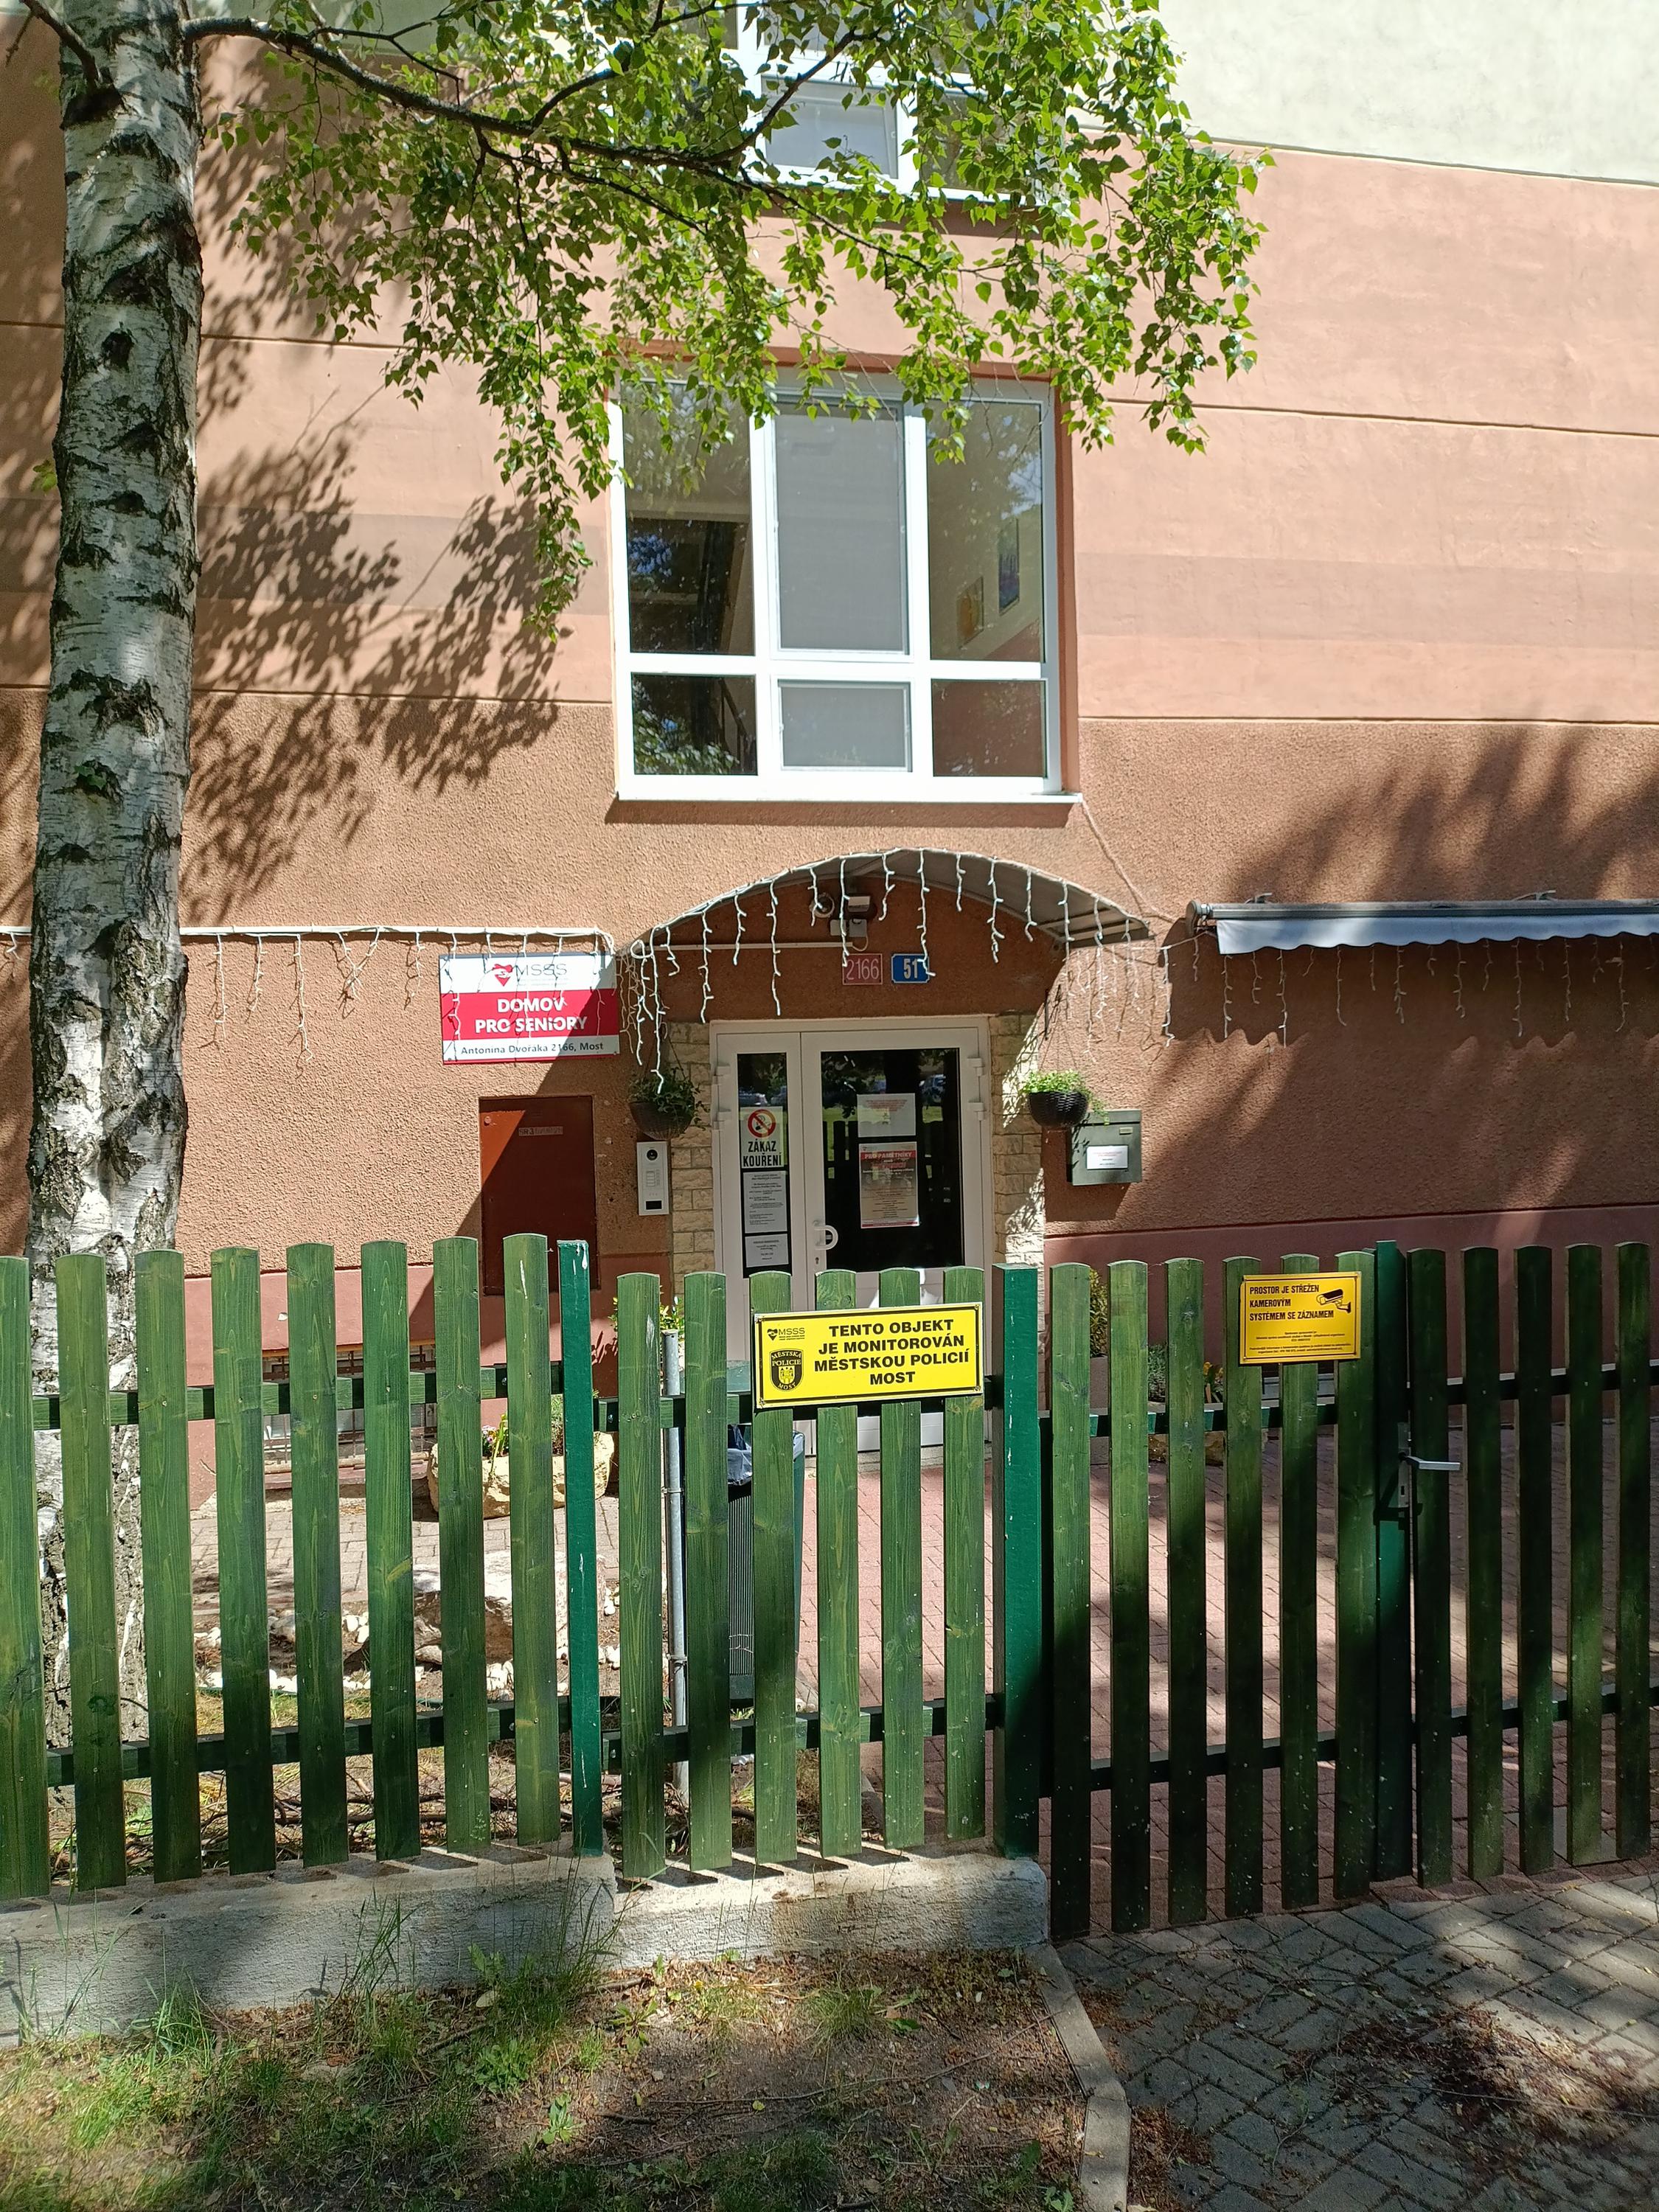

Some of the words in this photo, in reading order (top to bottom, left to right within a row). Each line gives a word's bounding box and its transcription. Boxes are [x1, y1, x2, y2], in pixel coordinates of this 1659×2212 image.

[515, 964, 568, 976] MSSS
[846, 958, 880, 981] 2166
[903, 958, 918, 979] 51
[498, 997, 564, 1013] DOMOV
[475, 1018, 511, 1034] PRO
[580, 1041, 604, 1052] Most
[748, 1138, 777, 1153] ZÁKAZ
[742, 1152, 782, 1167] KOUŘENÍ
[1249, 1286, 1280, 1295] PROSTOR
[1281, 1285, 1290, 1294] JE
[1291, 1283, 1320, 1293] STŘEŽEN
[1249, 1298, 1292, 1308] KAMEROVÝM
[1249, 1311, 1286, 1321] SYSTÉMEM
[1287, 1311, 1295, 1320] SE
[1297, 1310, 1335, 1320] ZÁZNAMEM
[779, 1327, 805, 1335] MSSS
[829, 1323, 885, 1338] TENTO
[889, 1319, 954, 1335] OBJEKT
[818, 1342, 839, 1354] JE
[844, 1333, 964, 1354] MONITOROVÁN
[771, 1359, 801, 1367] POLICIE
[814, 1355, 905, 1372] MĚSTSKOU
[911, 1348, 970, 1366] POLICIÍ
[869, 1371, 917, 1385] MOST
[777, 1381, 796, 1390] MOST
